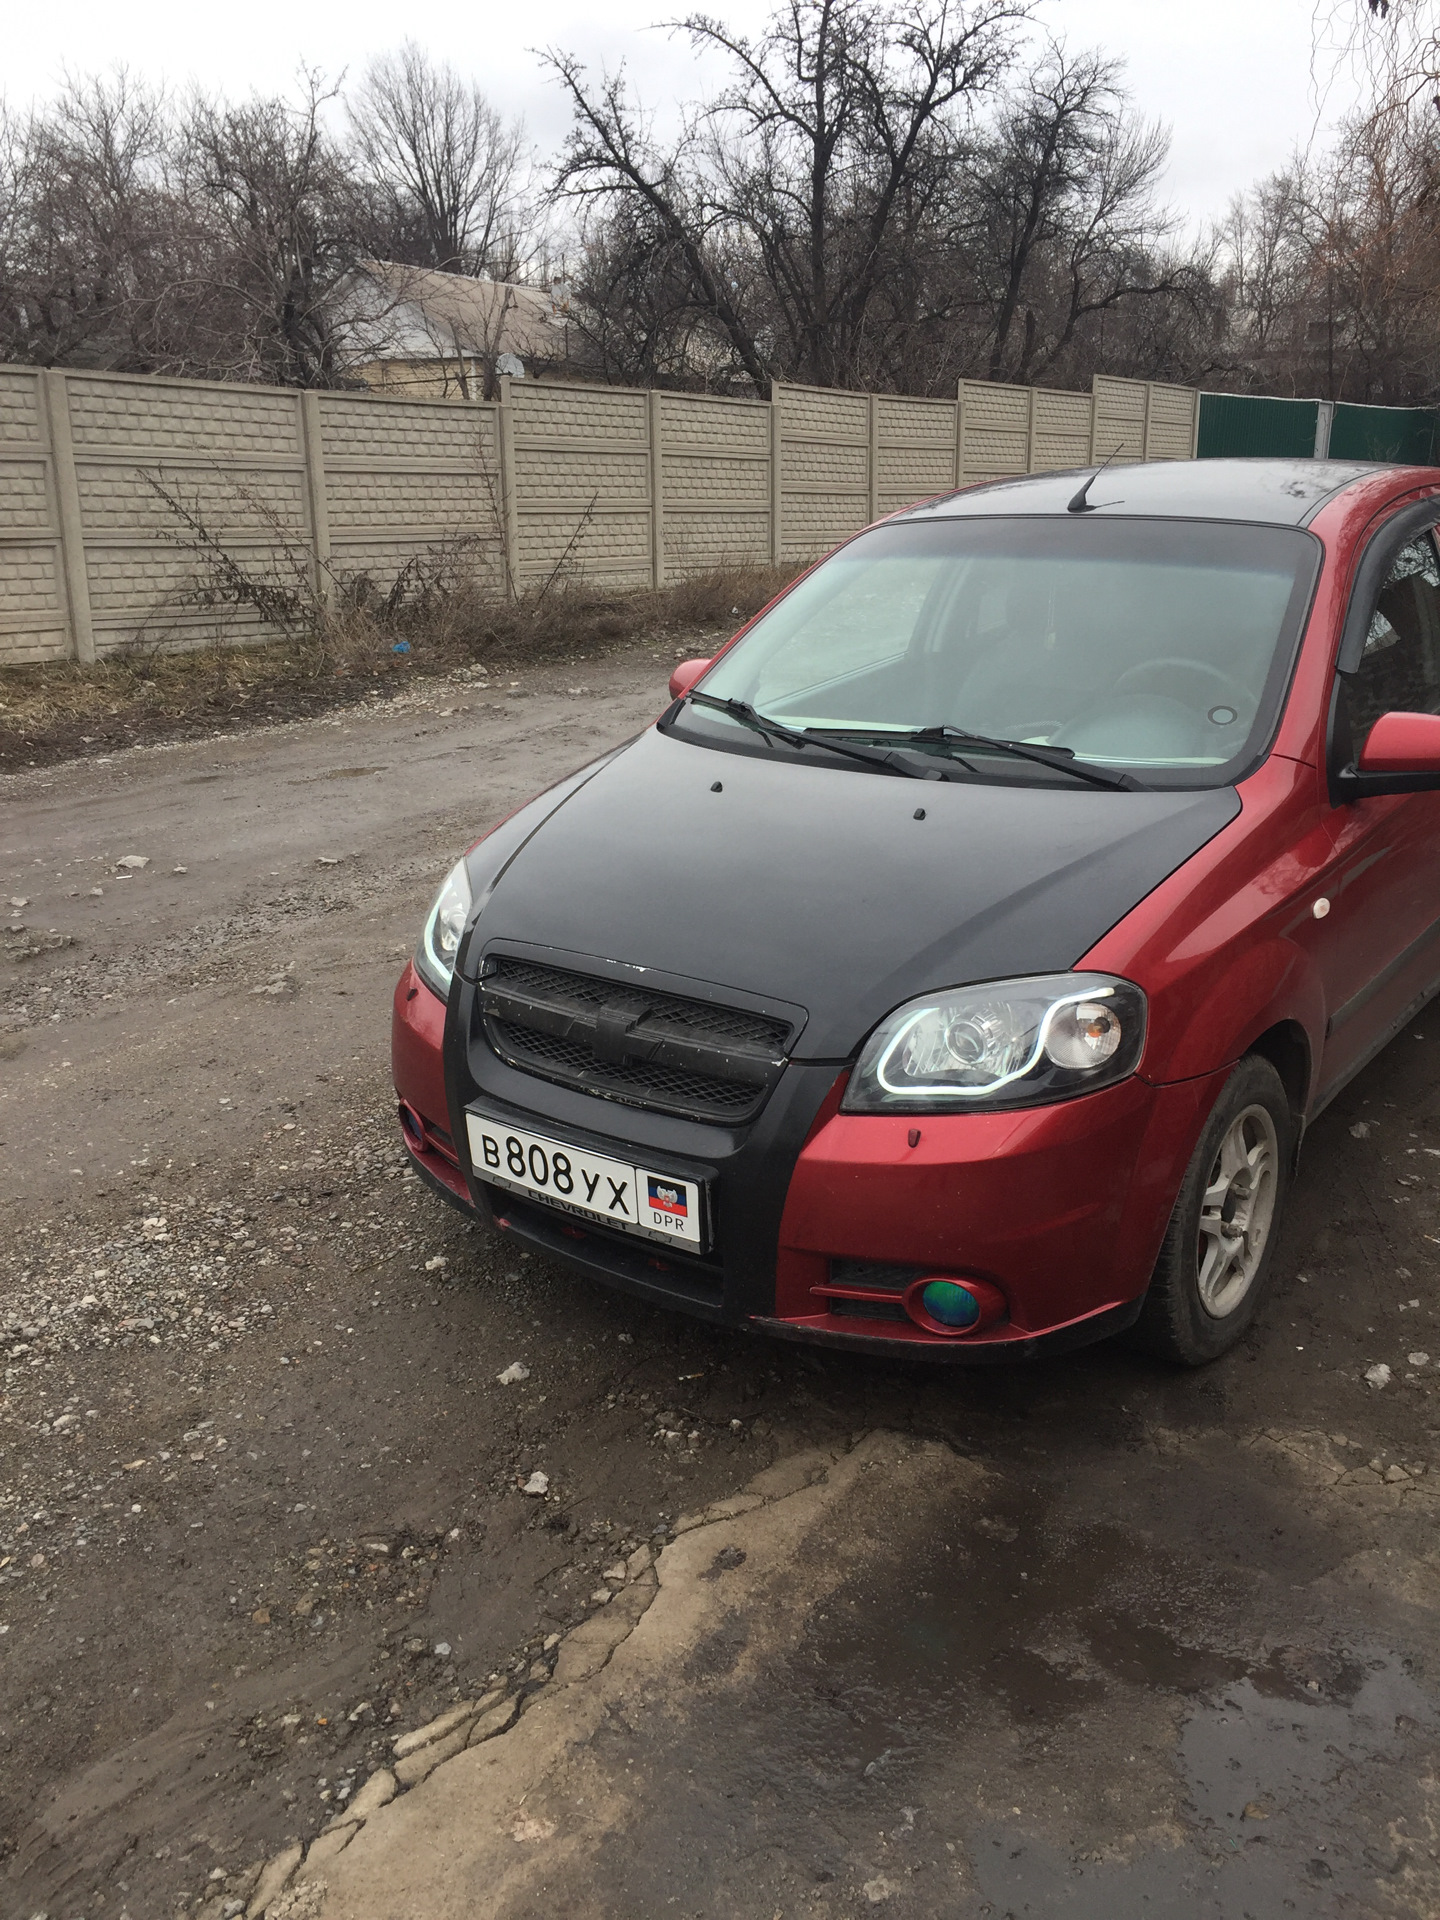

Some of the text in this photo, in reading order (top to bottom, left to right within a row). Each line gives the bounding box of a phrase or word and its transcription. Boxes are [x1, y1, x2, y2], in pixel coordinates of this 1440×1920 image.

[482, 1134, 630, 1215] В808УХ
[528, 1189, 629, 1230] CHEVROLET
[653, 1212, 685, 1232] DPR
